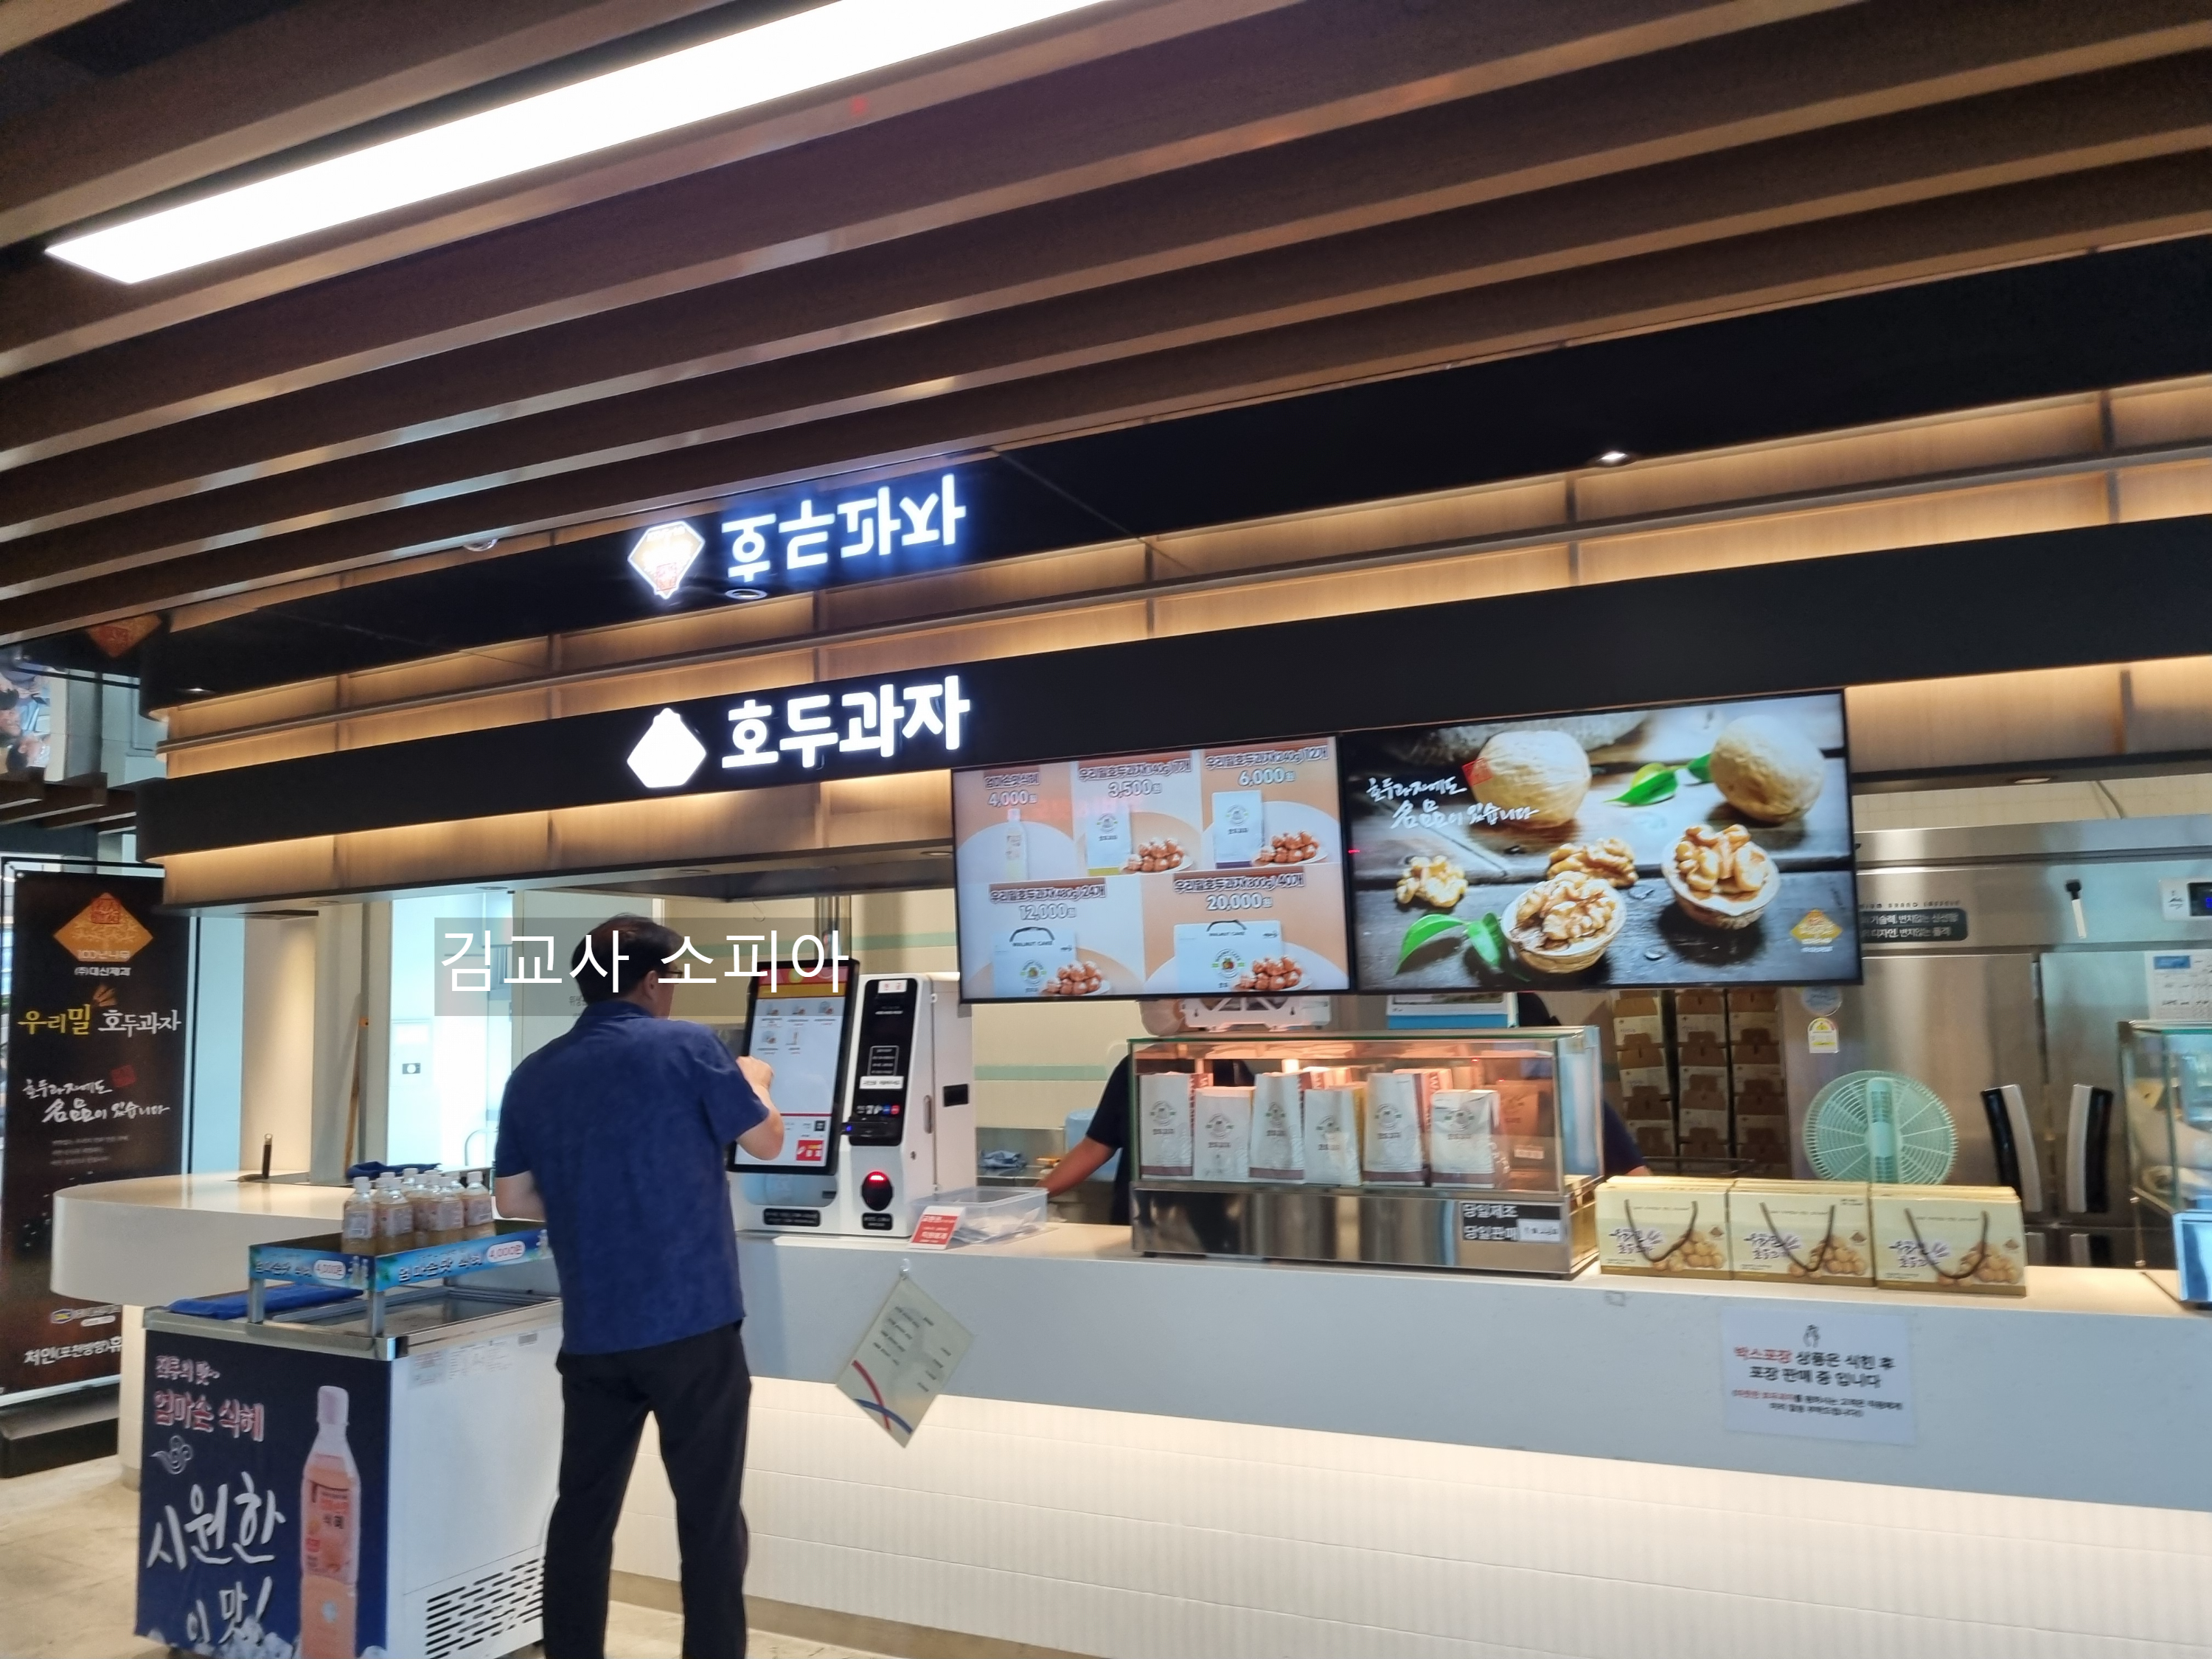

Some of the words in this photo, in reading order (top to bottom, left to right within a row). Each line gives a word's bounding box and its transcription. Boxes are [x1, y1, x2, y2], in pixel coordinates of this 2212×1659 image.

[721, 675, 971, 769] 호두과자
[1238, 767, 1296, 787] 6,000원
[988, 790, 1038, 808] 4,000원
[1108, 779, 1163, 799] 3,500원
[1206, 892, 1273, 911] 20,000원
[1018, 903, 1078, 922] 12,000원
[17, 1004, 91, 1035] 우리밀
[98, 1009, 182, 1038] 호두과자
[1464, 1203, 1519, 1219] 당일제조
[1749, 1366, 1778, 1381] 포장
[1781, 1368, 1813, 1383] 판매
[1834, 1371, 1882, 1389] 입니다
[153, 1388, 215, 1433] 엄마손
[218, 1398, 265, 1443] 식혜
[147, 1471, 286, 1571] 시원한
